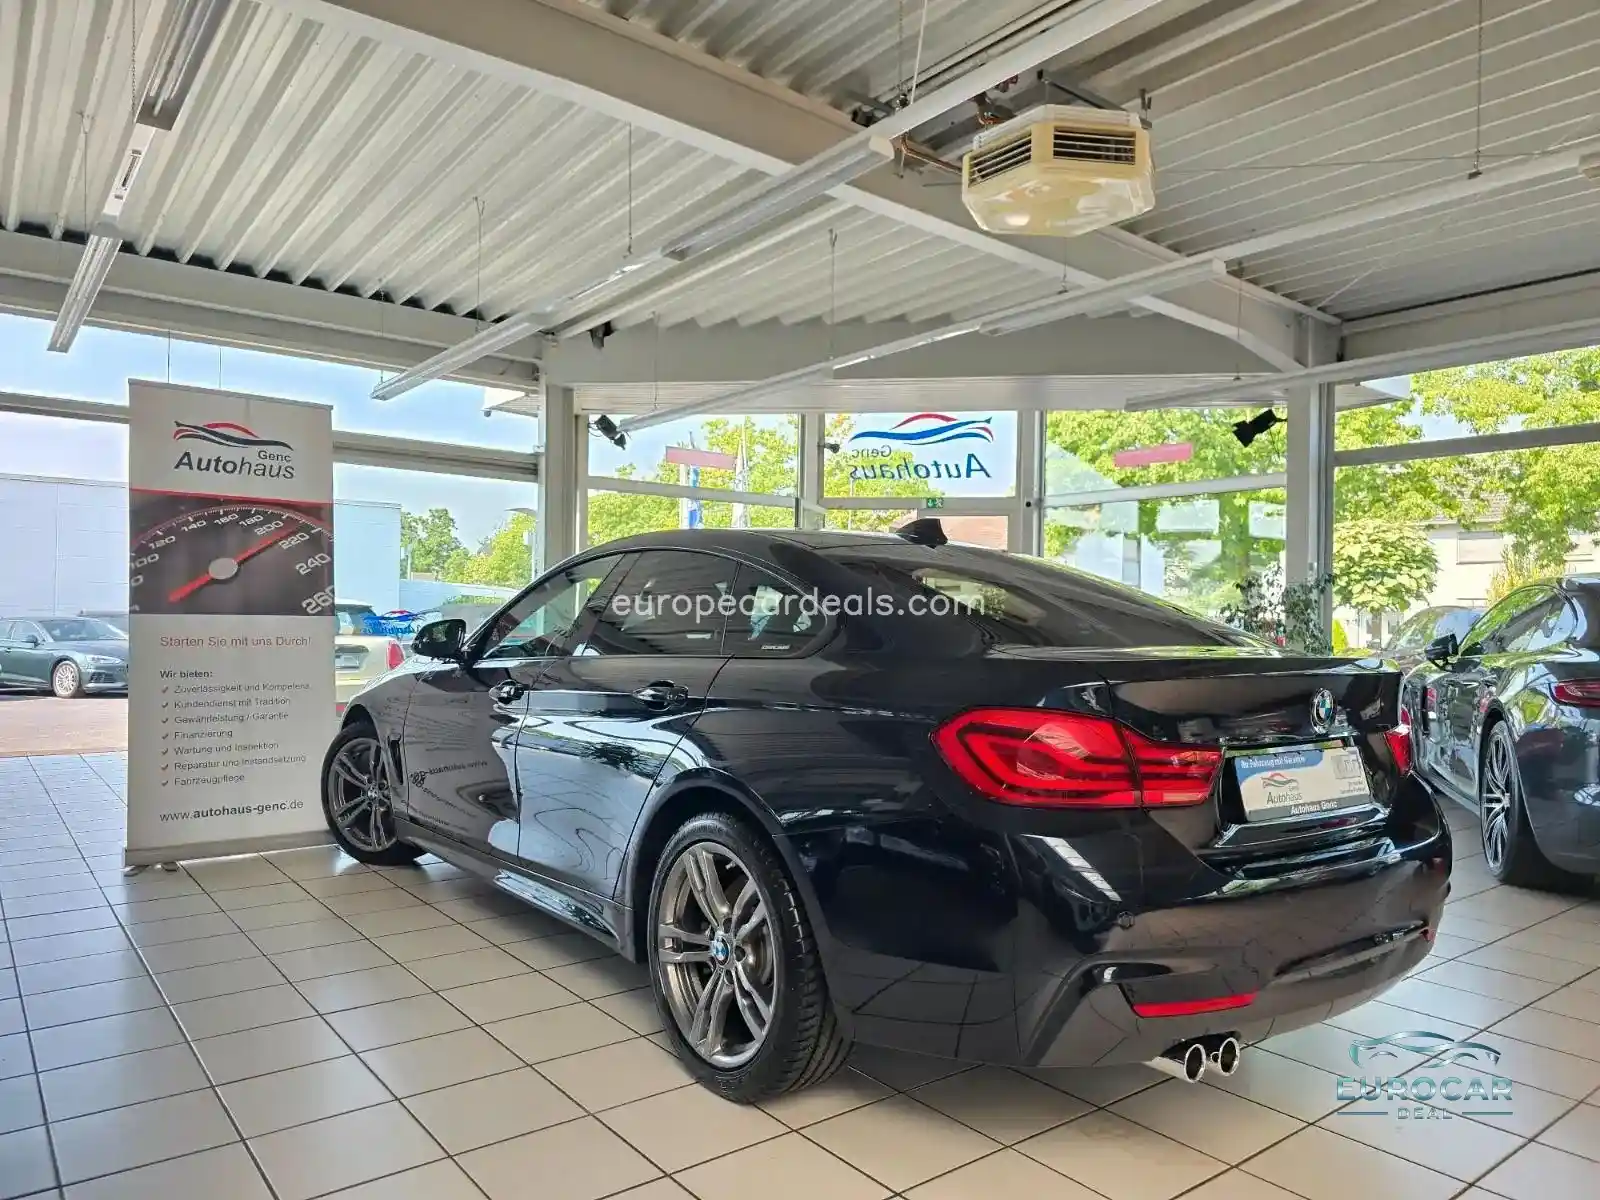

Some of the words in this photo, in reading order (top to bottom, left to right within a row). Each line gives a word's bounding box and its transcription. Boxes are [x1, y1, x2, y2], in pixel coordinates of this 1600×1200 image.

[258, 450, 292, 463] Genc
[174, 451, 295, 479] Autohaus
[181, 520, 207, 532] 140
[254, 520, 284, 535] 200
[279, 532, 310, 550] 220
[295, 553, 332, 575] 240
[160, 636, 204, 648] Starten
[208, 636, 227, 648] Sie
[231, 636, 248, 647] mit
[252, 638, 272, 647] uns
[276, 635, 312, 647] Durch!
[160, 669, 177, 679] Wir
[180, 669, 213, 679] bieten:
[174, 684, 242, 694] Zuverlässigkeit
[245, 682, 260, 691] und
[174, 699, 236, 709] Kundendienst
[238, 698, 252, 707] mit
[255, 696, 291, 706] Tradition
[252, 711, 289, 721] Garantie
[174, 729, 233, 740] Finanzierung
[174, 745, 213, 755] Wartung
[215, 744, 232, 752] und
[235, 741, 279, 752] Inspektion
[174, 761, 221, 772] Reparatur
[222, 759, 240, 768] und
[242, 755, 306, 766] Instandsetzung
[174, 774, 245, 787] Fahrzeugpflege
[1266, 791, 1302, 805] Autohaus
[160, 798, 304, 822] www.autohaus-genc.de
[1291, 803, 1320, 815] Autohaus
